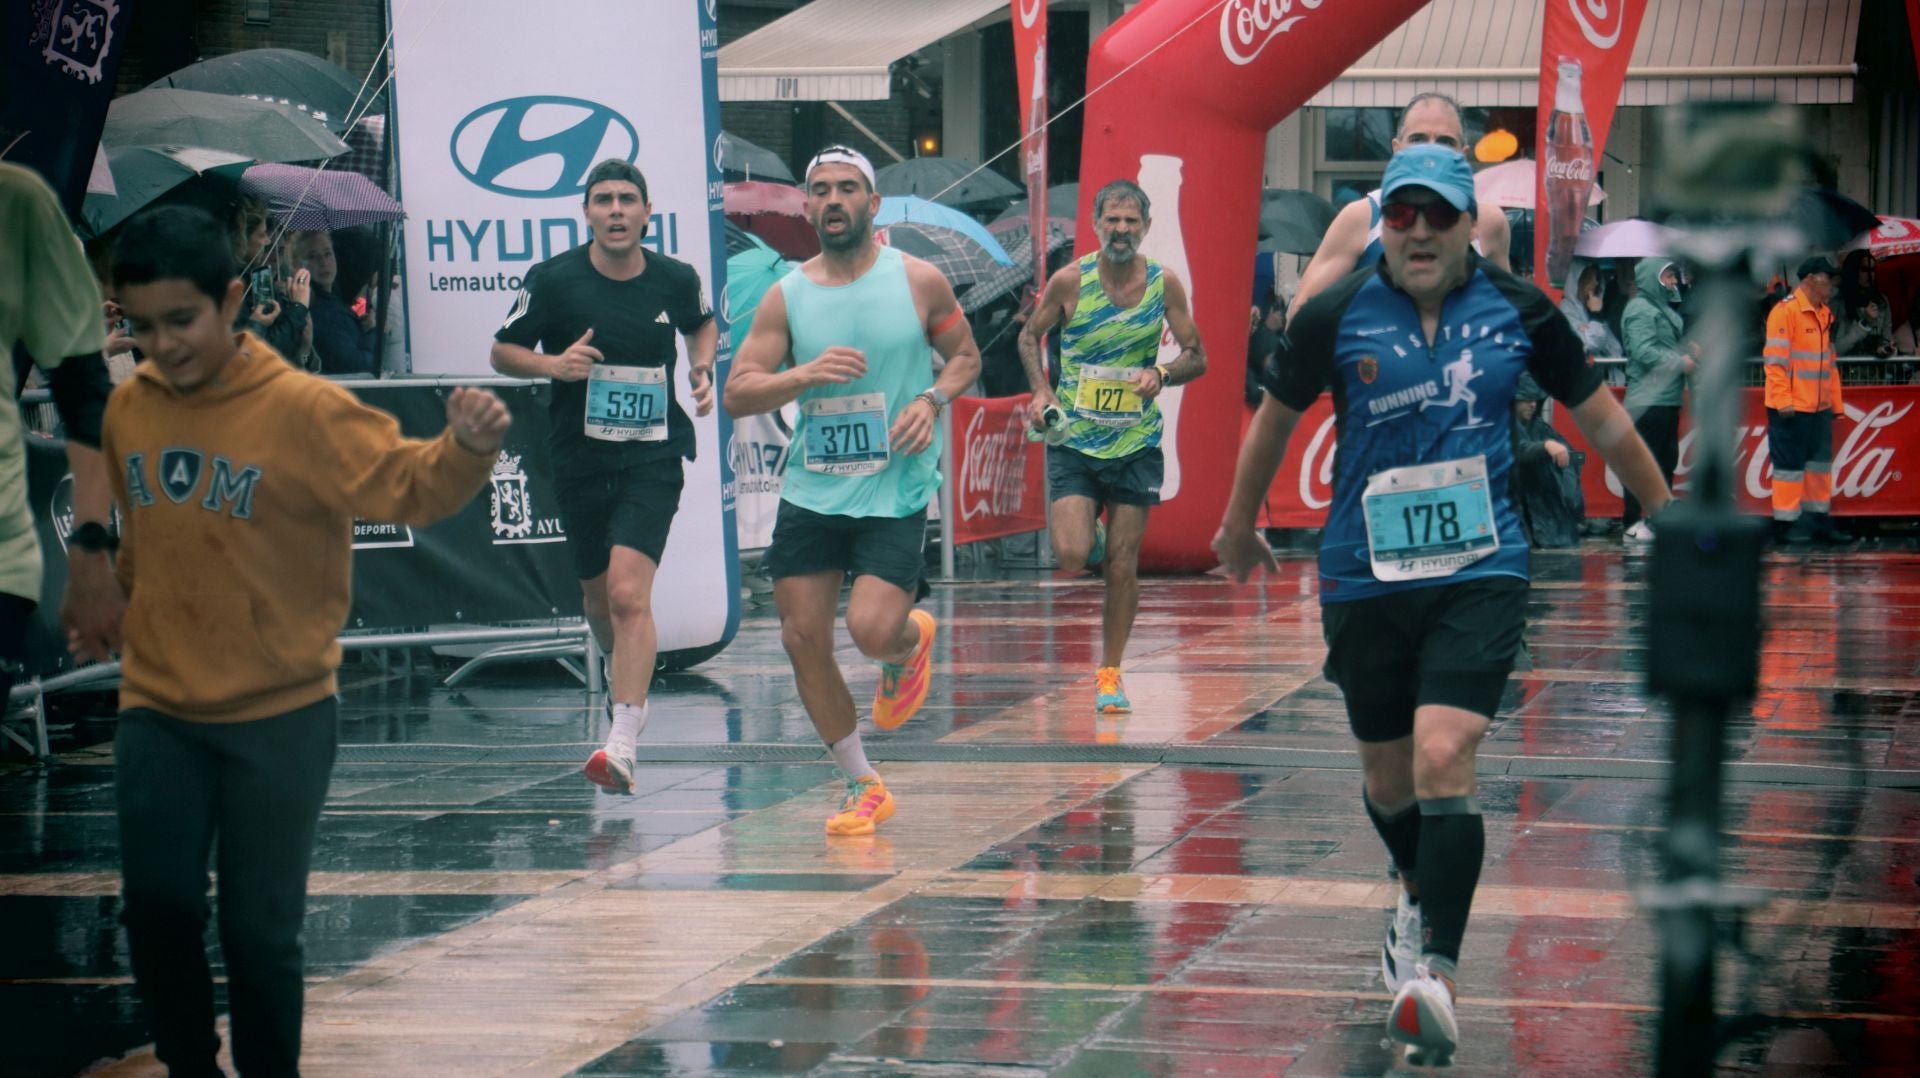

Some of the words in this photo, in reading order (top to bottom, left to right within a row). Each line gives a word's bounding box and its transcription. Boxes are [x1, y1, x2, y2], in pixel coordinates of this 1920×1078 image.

[427, 213, 679, 263] HYUNAI
[607, 391, 654, 419] 530
[1095, 388, 1124, 411] 127
[1368, 380, 1439, 415] RUNNING
[617, 428, 653, 437] HYUNDAI
[821, 423, 870, 455] 370
[838, 461, 875, 472] HYUNDAI
[353, 524, 397, 536] DEPORTE
[1403, 501, 1460, 546] 178
[1421, 553, 1480, 569] HYUNDAI
